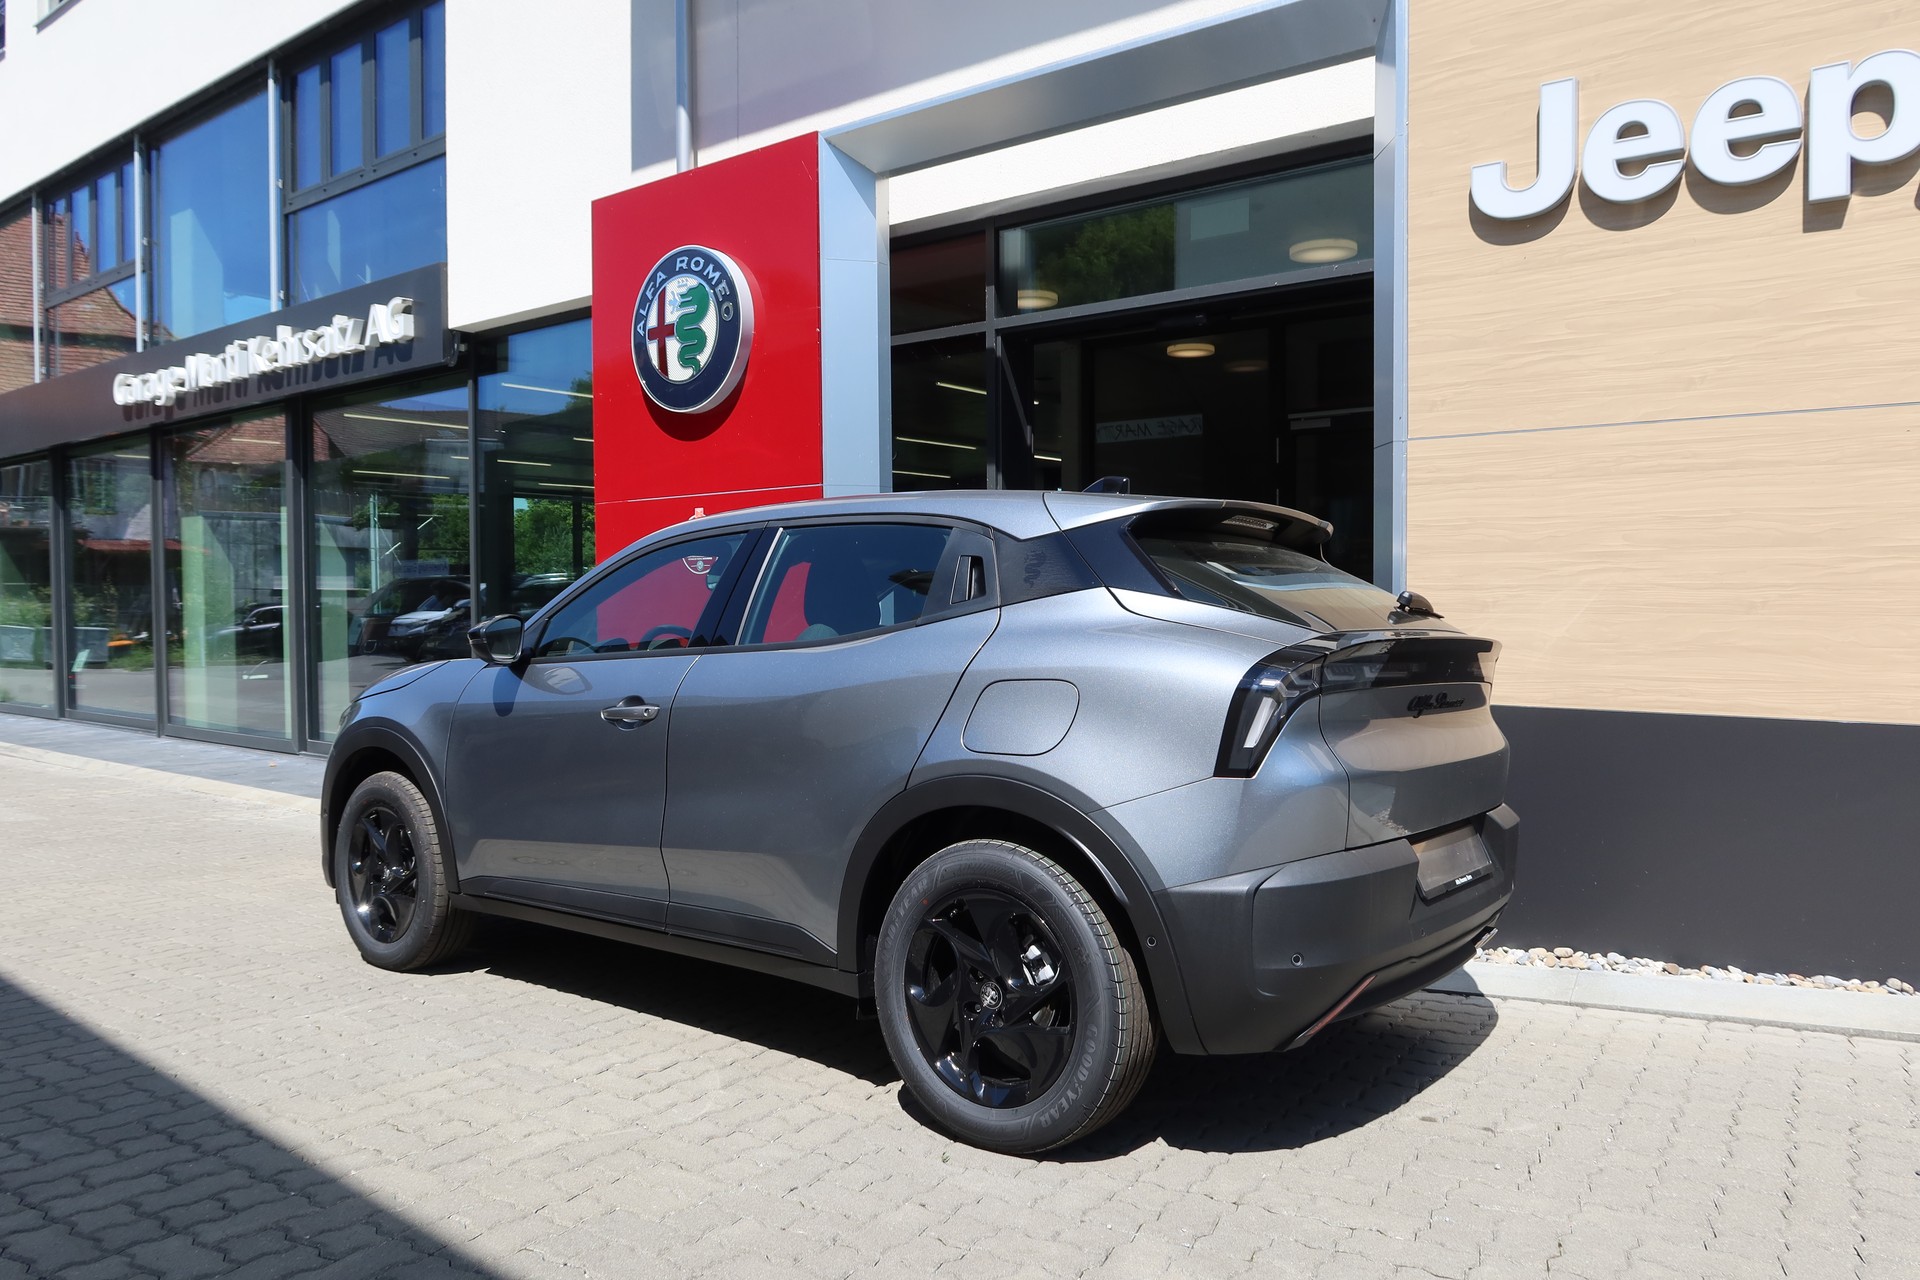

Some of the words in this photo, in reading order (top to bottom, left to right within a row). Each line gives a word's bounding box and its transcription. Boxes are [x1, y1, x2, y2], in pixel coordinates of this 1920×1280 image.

[1470, 48, 1920, 219] Jeep
[636, 271, 668, 337] ALFA
[675, 256, 735, 322] ROMEO
[113, 366, 188, 406] Garage
[185, 339, 249, 391] Marti
[247, 314, 366, 375] Kehrsatz
[365, 296, 414, 346] AG
[1040, 1023, 1098, 1128] GOODYEAR
